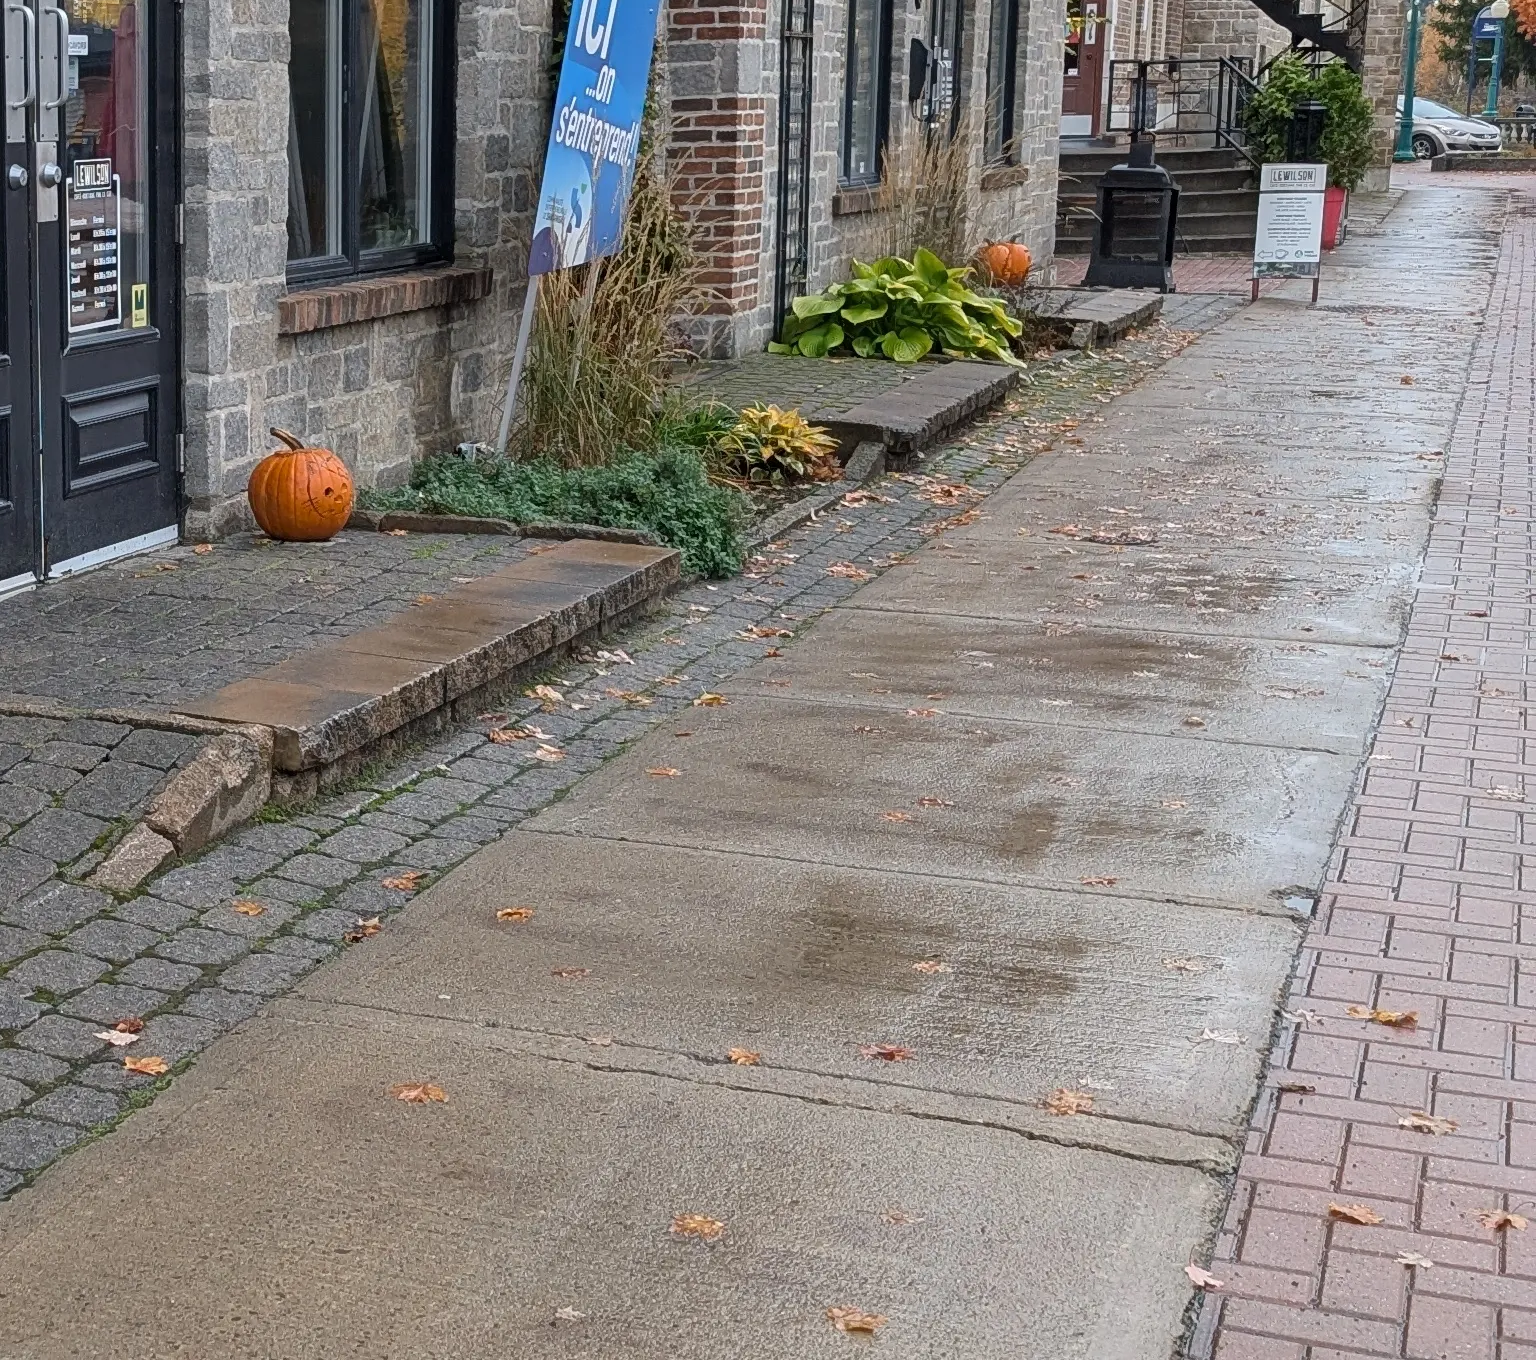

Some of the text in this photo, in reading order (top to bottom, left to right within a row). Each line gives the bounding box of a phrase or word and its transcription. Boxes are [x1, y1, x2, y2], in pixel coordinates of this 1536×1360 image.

[555, 96, 639, 169] s'entreprend!
[76, 163, 110, 187] LEWILSON
[1272, 170, 1314, 182] LEWILSON
